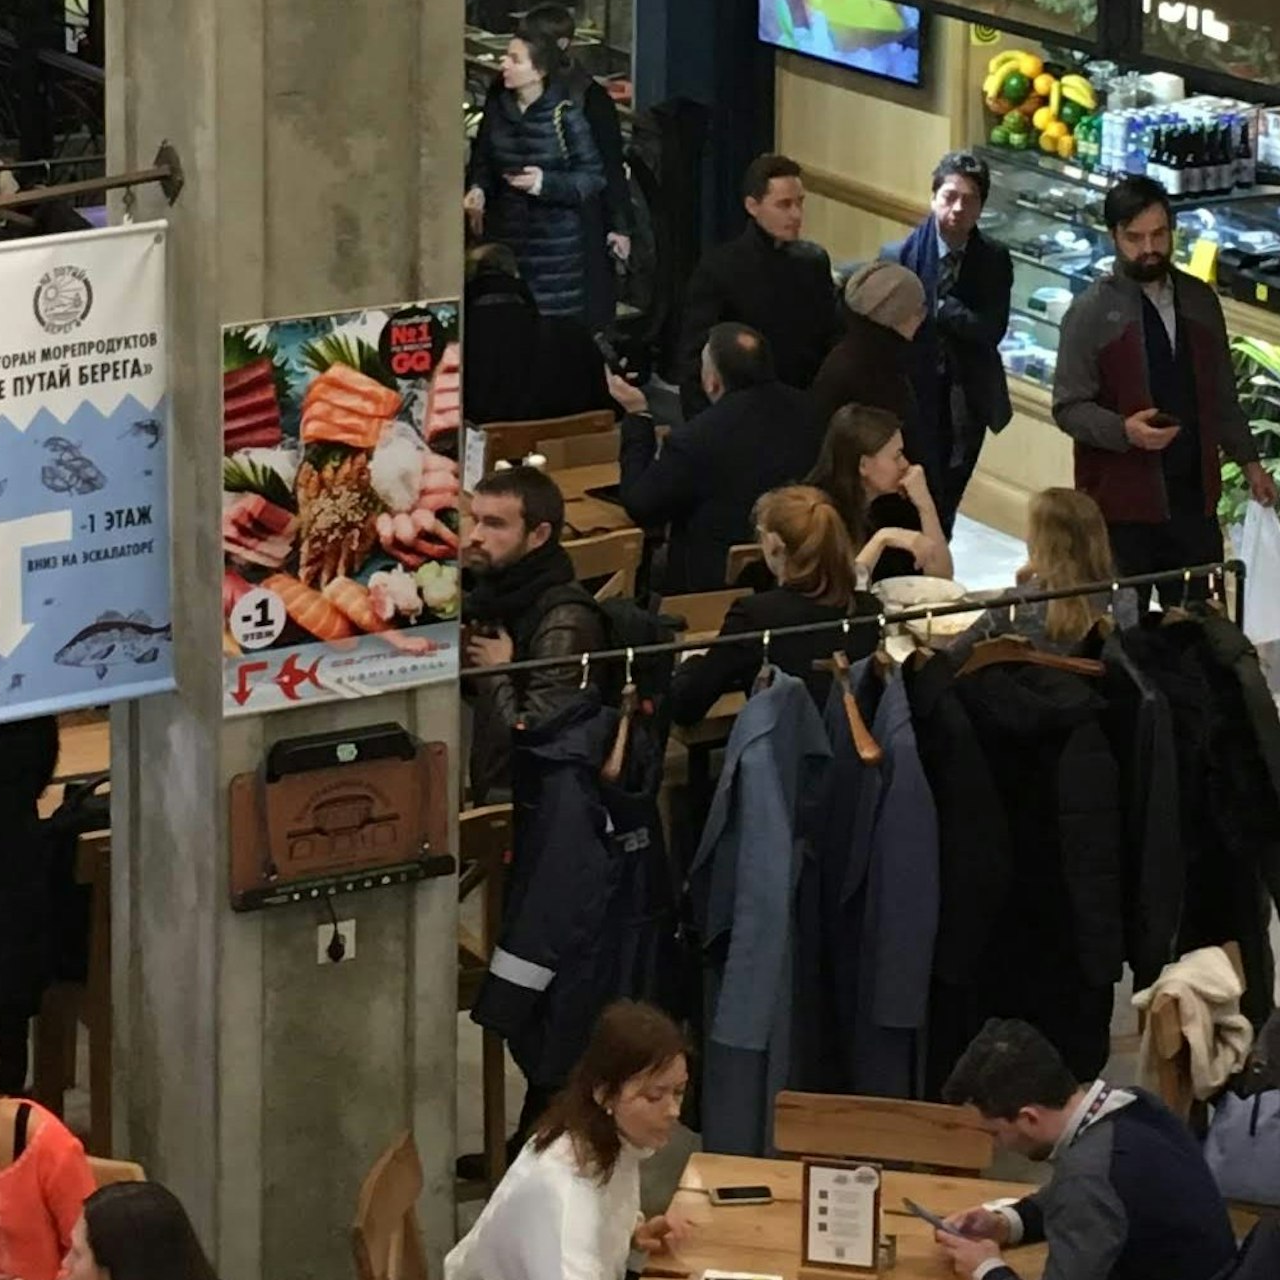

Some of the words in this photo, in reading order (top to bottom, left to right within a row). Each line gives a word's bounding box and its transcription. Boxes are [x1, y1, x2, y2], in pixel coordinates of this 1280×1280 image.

[40, 332, 158, 362] МОРЕПРОДУКТОВ
[13, 363, 71, 397] ПУТАЙ
[78, 357, 154, 386] БЕРЕГА»
[80, 514, 96, 533] -1
[104, 505, 153, 531] ЭТАЖ
[27, 556, 58, 572] ВНИЗ
[62, 553, 78, 567] НА
[82, 538, 154, 564] ЭСКАЛАТОРЕ
[241, 598, 274, 628] -1
